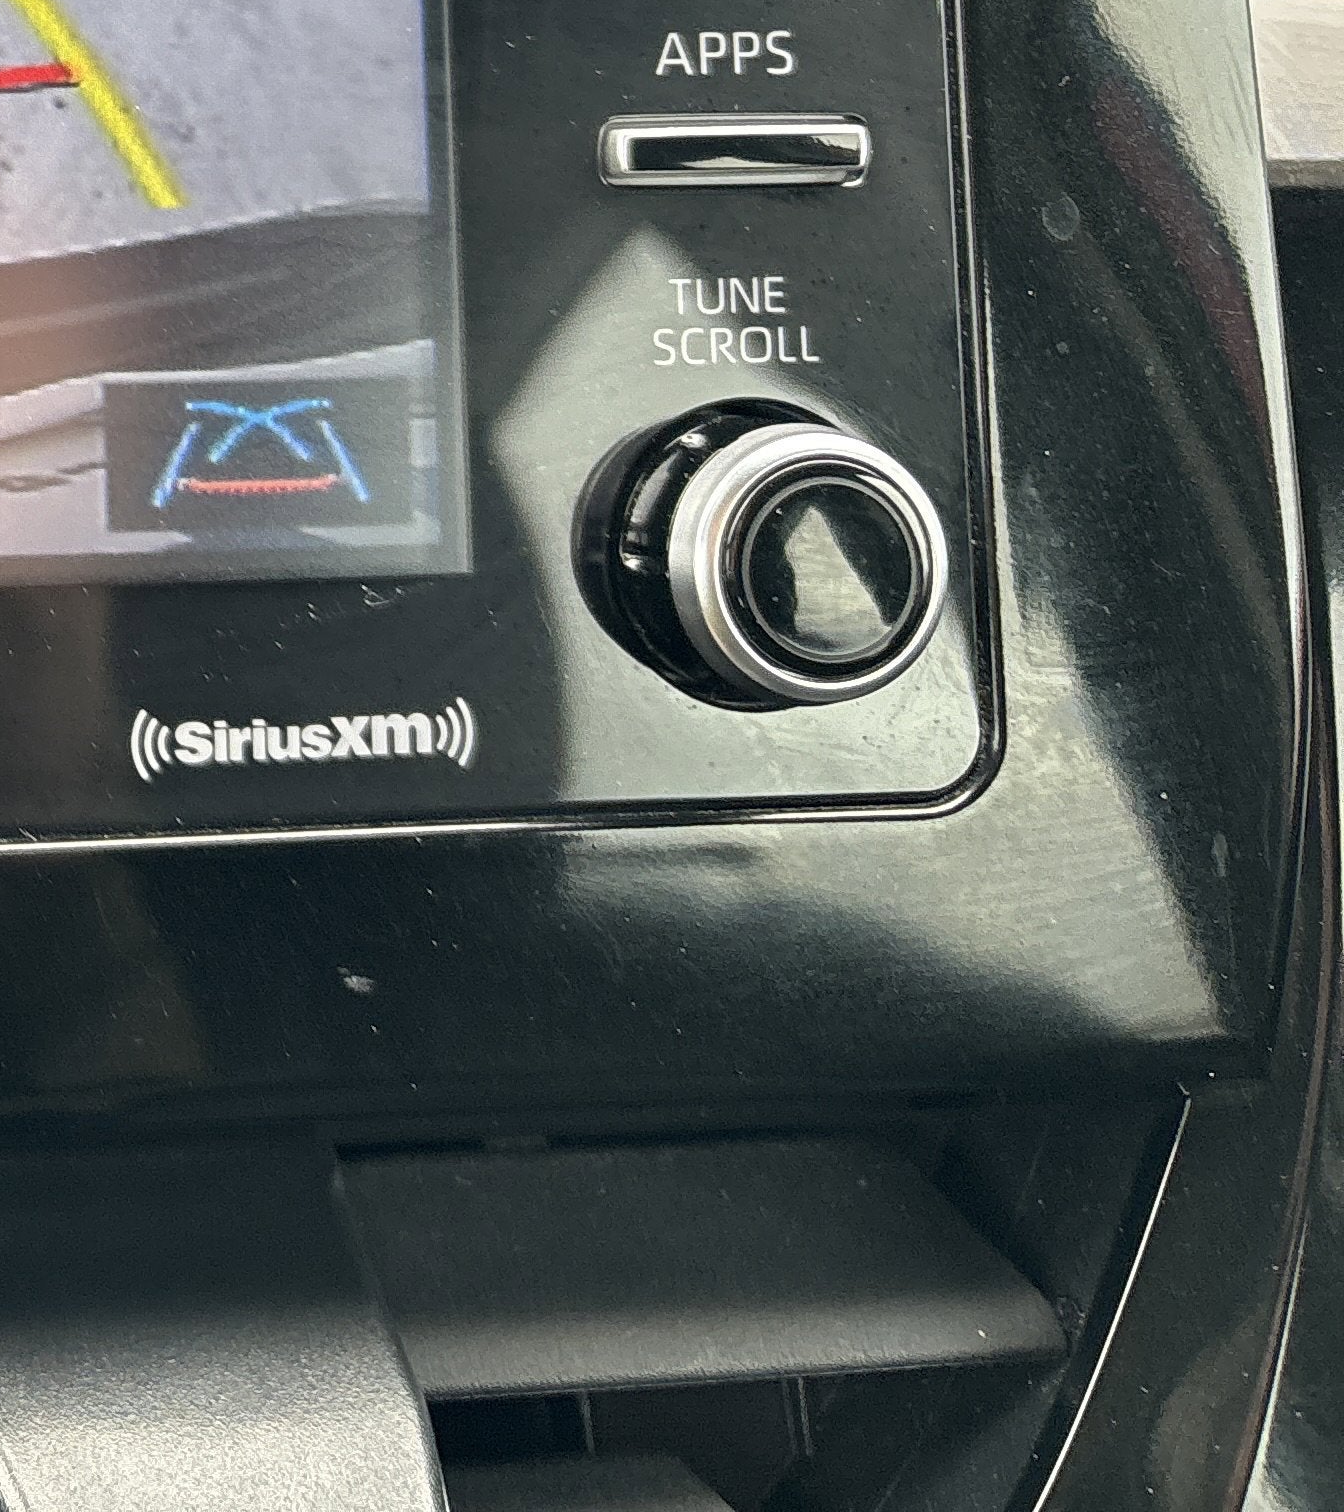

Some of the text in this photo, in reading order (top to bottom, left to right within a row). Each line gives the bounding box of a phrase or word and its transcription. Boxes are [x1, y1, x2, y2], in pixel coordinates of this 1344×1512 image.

[654, 29, 797, 77] APPS
[666, 274, 789, 315] TUNE
[651, 324, 822, 367] SCROLL
